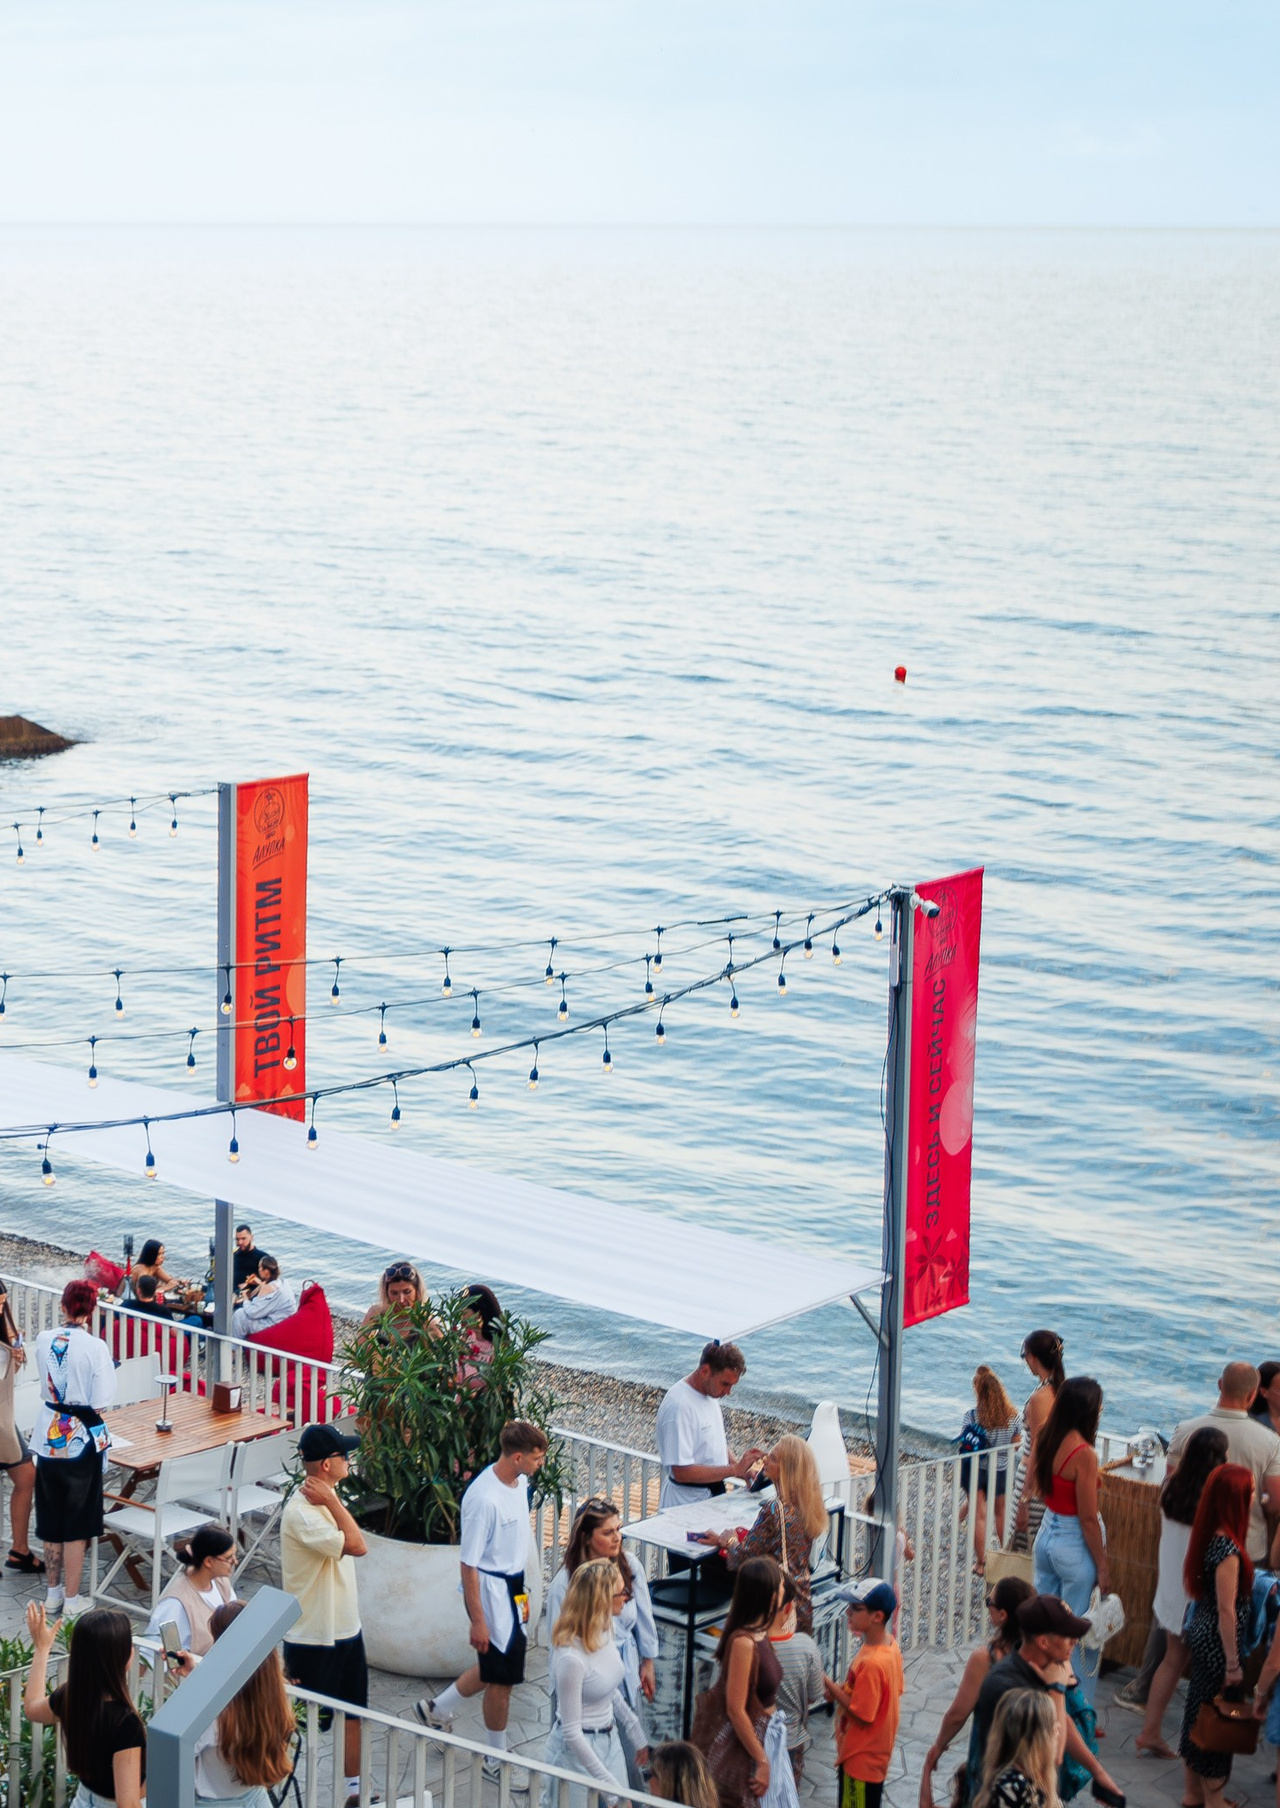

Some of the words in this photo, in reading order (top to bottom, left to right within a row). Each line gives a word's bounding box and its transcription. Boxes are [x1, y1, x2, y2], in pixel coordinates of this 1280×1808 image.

[252, 836, 285, 866] АЛУПКА
[254, 876, 282, 977] РИТМ
[249, 984, 282, 1079] ТВОЙ
[927, 978, 947, 1096] СЕЙЧАС
[928, 1102, 941, 1124] И
[925, 1130, 942, 1229] ЗДЕСЬ
